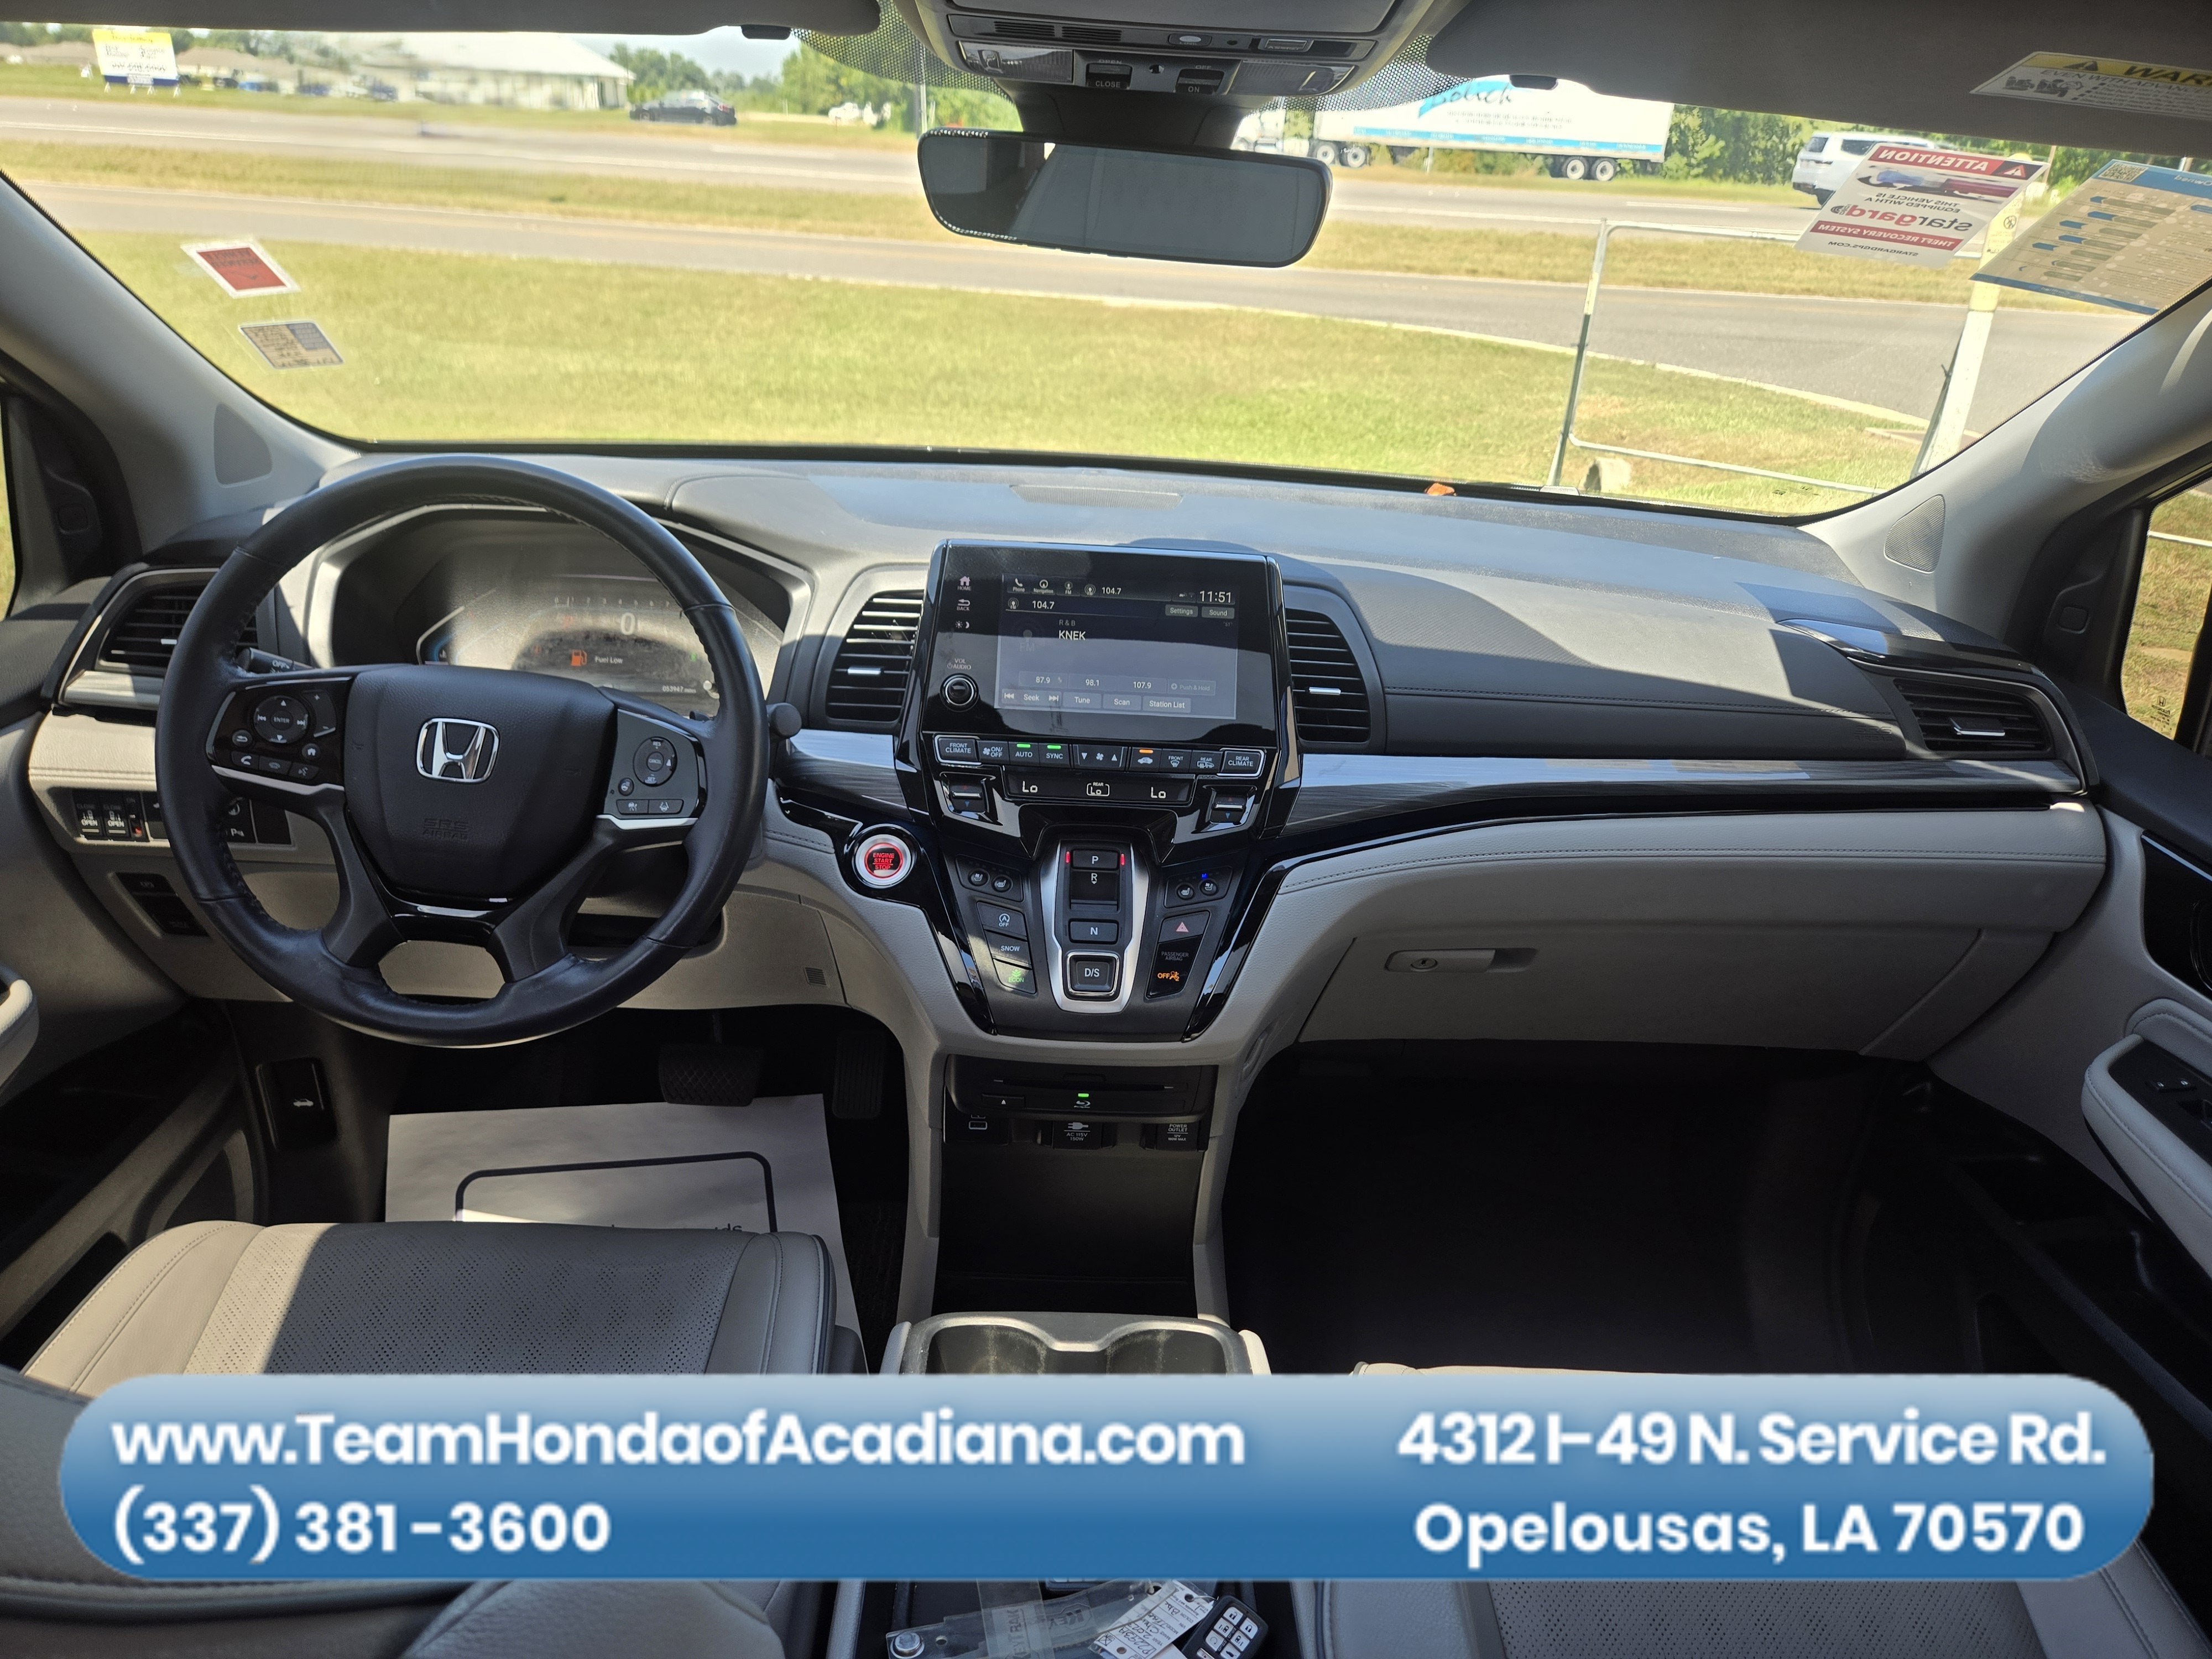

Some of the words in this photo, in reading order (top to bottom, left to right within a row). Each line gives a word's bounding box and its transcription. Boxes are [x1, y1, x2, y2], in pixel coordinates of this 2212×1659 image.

[2124, 65, 2212, 86] WAR
[1095, 80, 1121, 88] CLOSE
[1101, 586, 1122, 596] 104.7
[1199, 590, 1232, 603] 11:51
[1032, 600, 1055, 610] 104.7
[1170, 607, 1193, 615] Settings
[620, 612, 635, 635] 0
[1058, 630, 1087, 641] KNEK
[1086, 679, 1100, 687] 98.1
[1133, 681, 1152, 690] 107.9
[1024, 693, 1039, 702] Seek
[1149, 700, 1172, 708] Station
[1022, 780, 1039, 793] Lo
[1091, 786, 1102, 795] Lo
[1151, 786, 1166, 799] Lo
[1092, 855, 1099, 864] P
[1091, 873, 1098, 881] R
[1090, 927, 1098, 935] N
[1084, 968, 1099, 978] D/S
